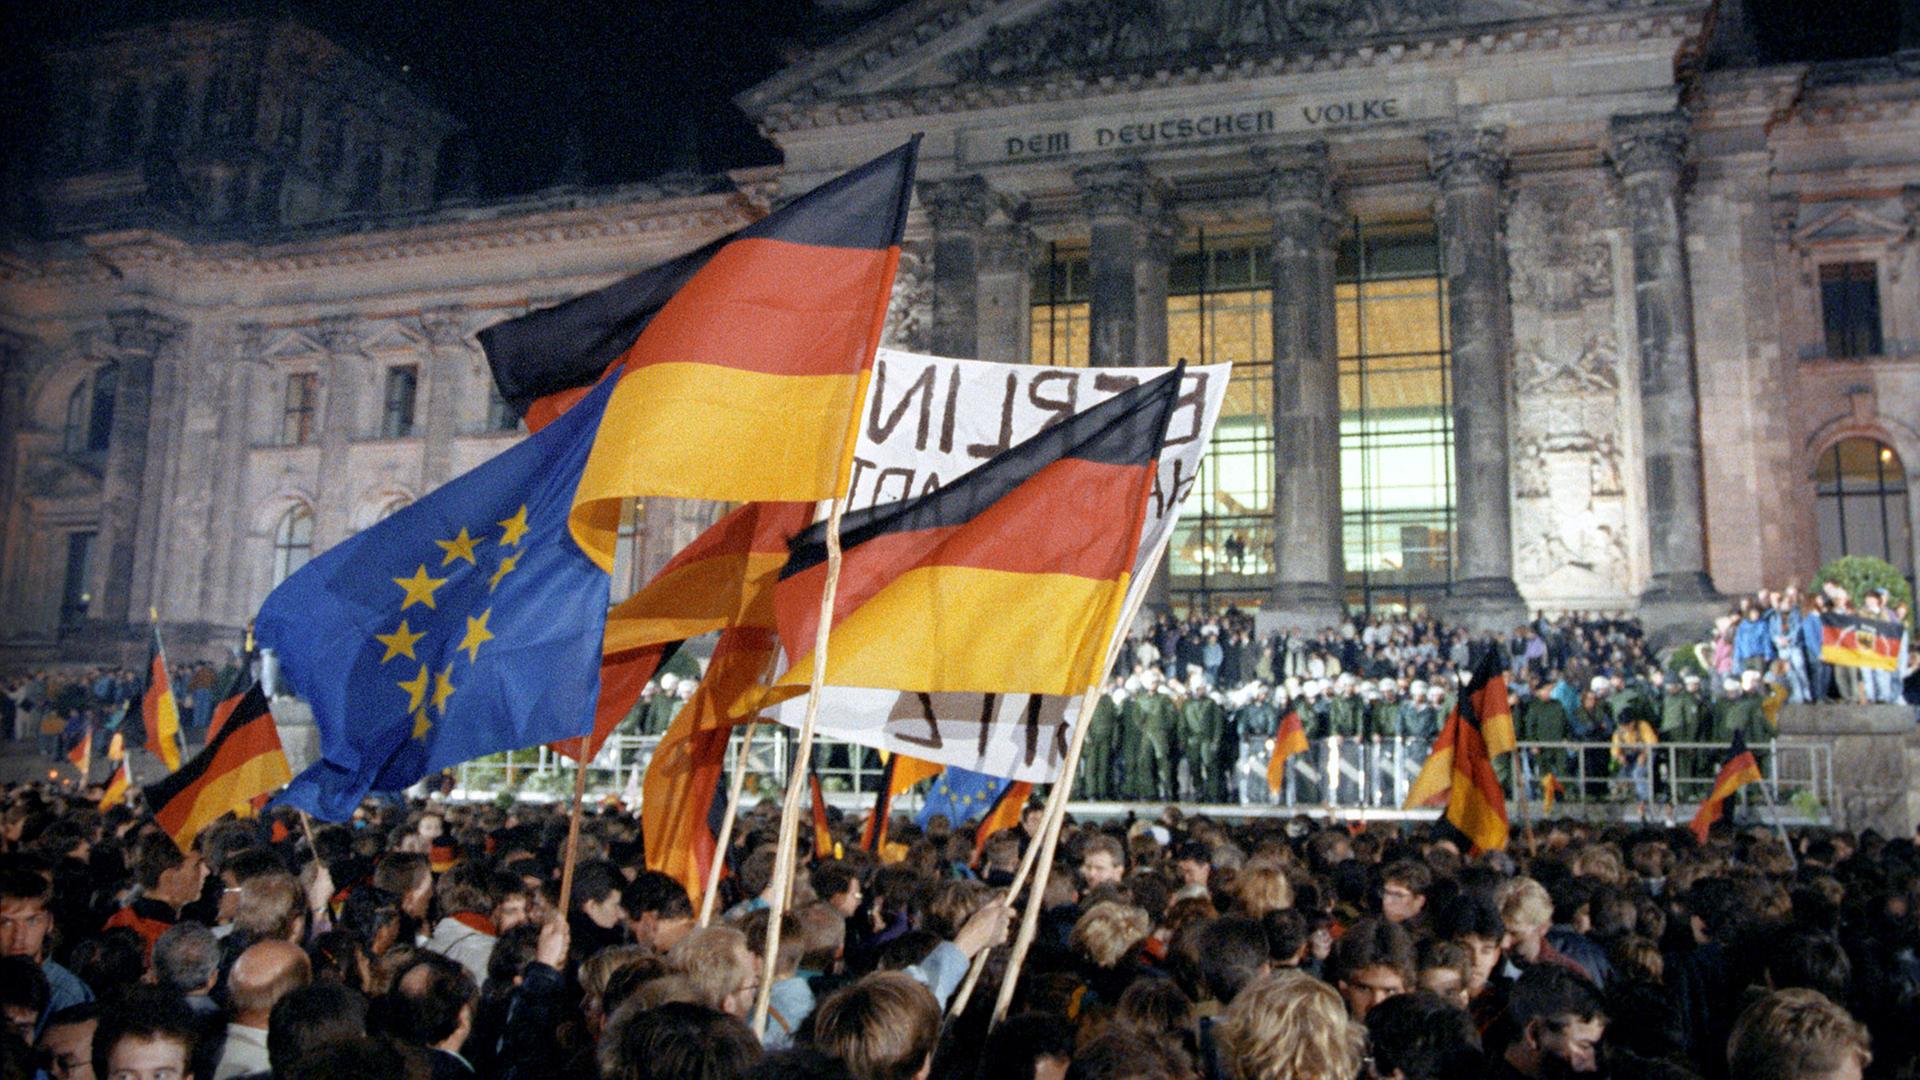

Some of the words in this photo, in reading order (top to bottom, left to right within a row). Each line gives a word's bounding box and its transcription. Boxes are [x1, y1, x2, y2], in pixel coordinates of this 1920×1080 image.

[1006, 131, 1071, 156] DEM
[1096, 110, 1275, 147] DEUTSCHEN
[1303, 99, 1398, 125] VOLKE
